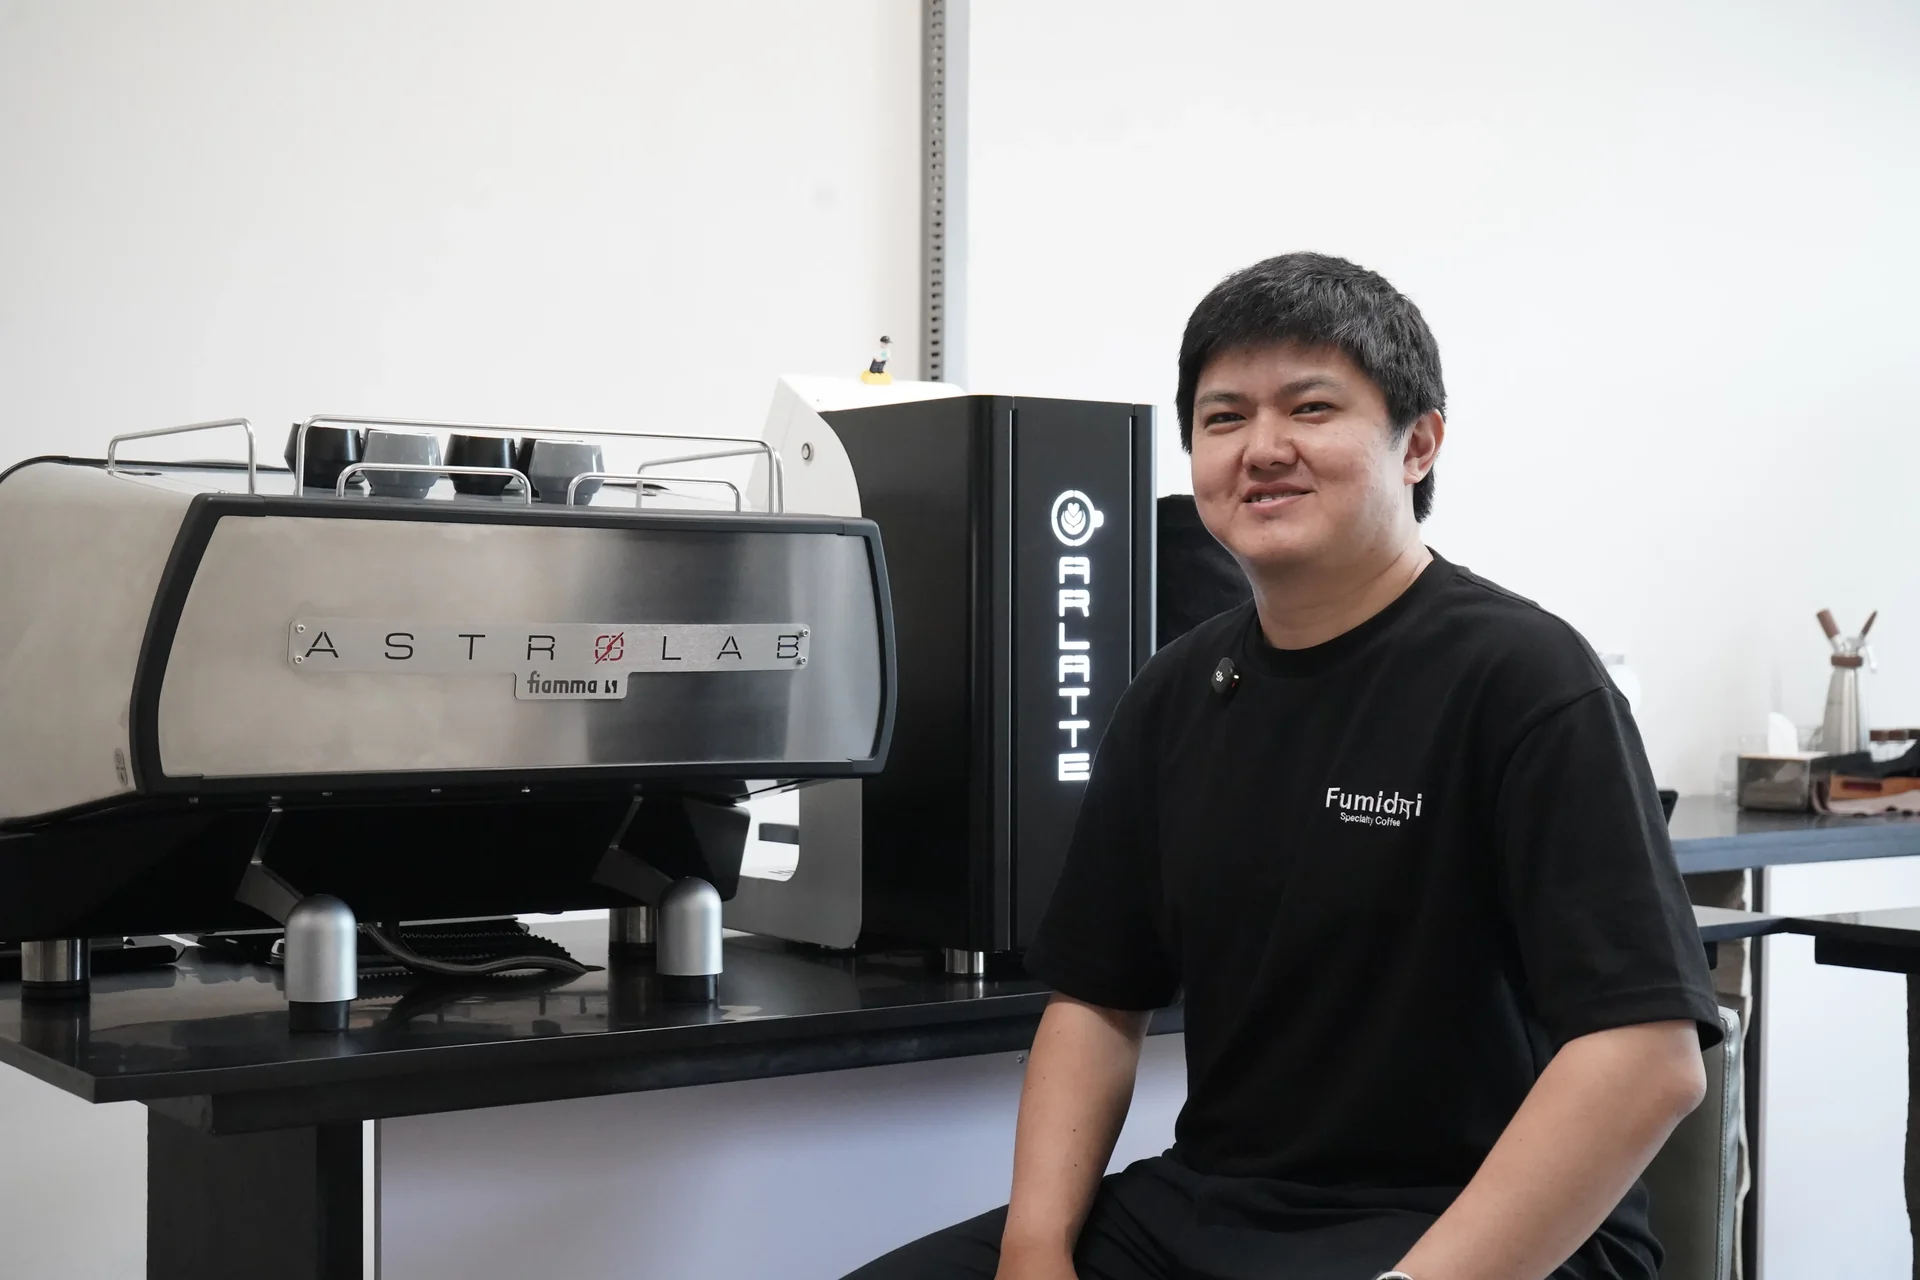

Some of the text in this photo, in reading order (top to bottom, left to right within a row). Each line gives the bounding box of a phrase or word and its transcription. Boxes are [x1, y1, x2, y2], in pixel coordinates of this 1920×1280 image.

[1058, 556, 1091, 782] ARLATTE
[526, 670, 598, 694] fiamma
[1340, 811, 1401, 827] Specialty Coffee
